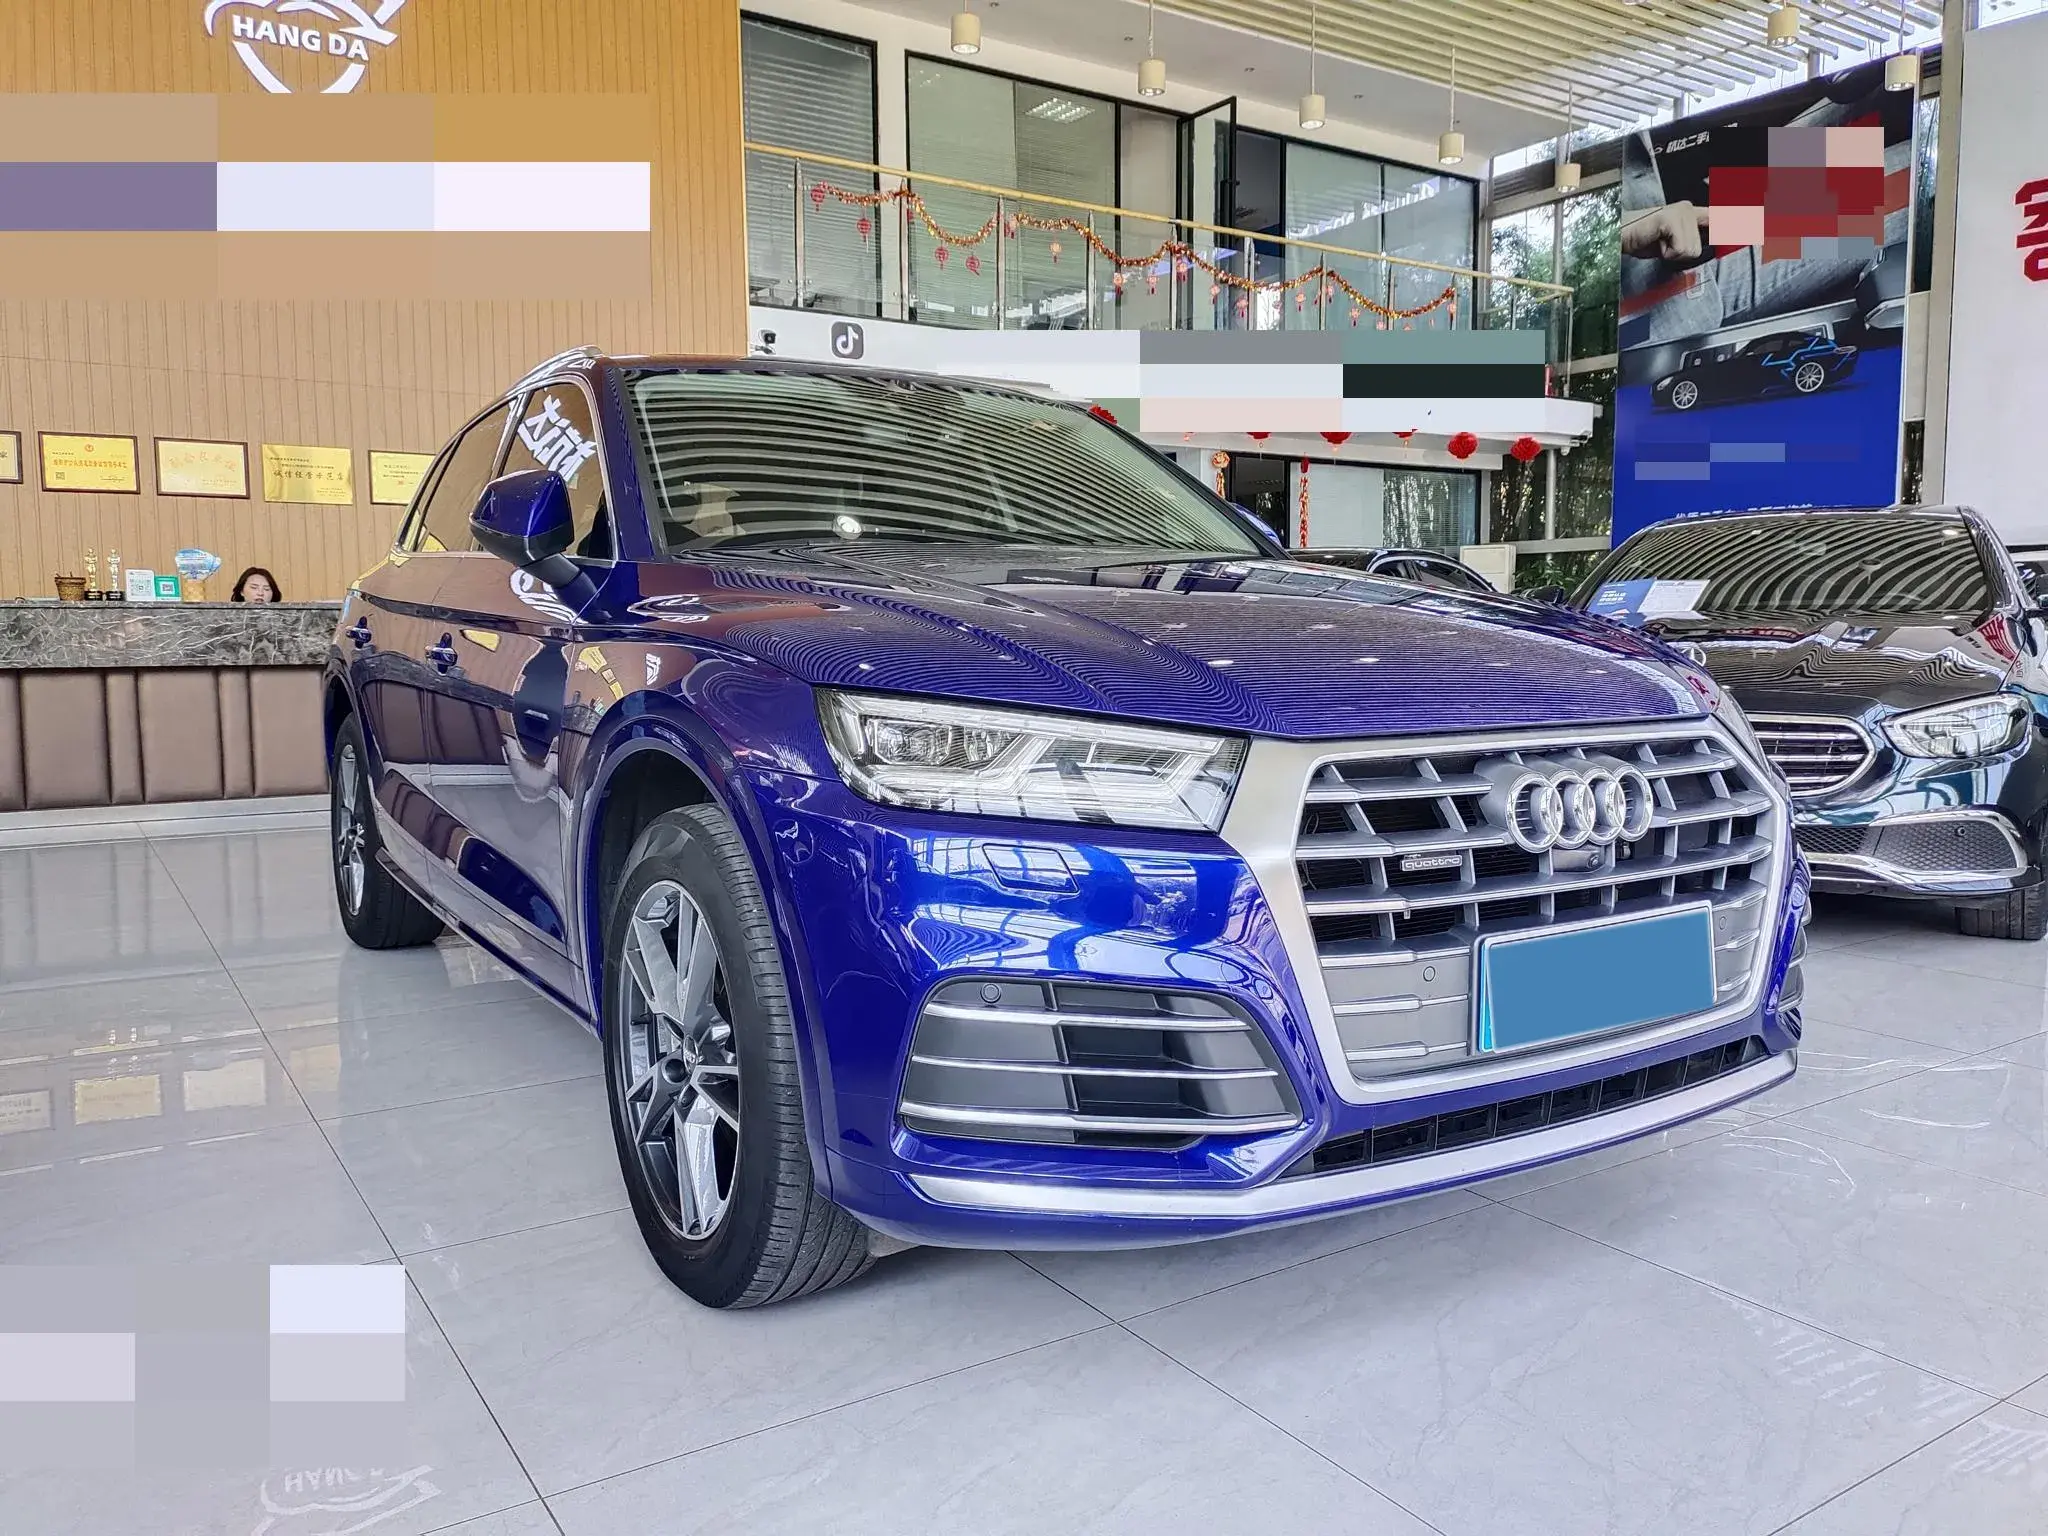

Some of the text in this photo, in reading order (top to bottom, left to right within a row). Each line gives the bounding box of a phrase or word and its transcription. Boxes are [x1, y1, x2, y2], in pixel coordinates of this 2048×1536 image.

[232, 14, 369, 61] HANG DA
[1404, 857, 1460, 870] quattro
